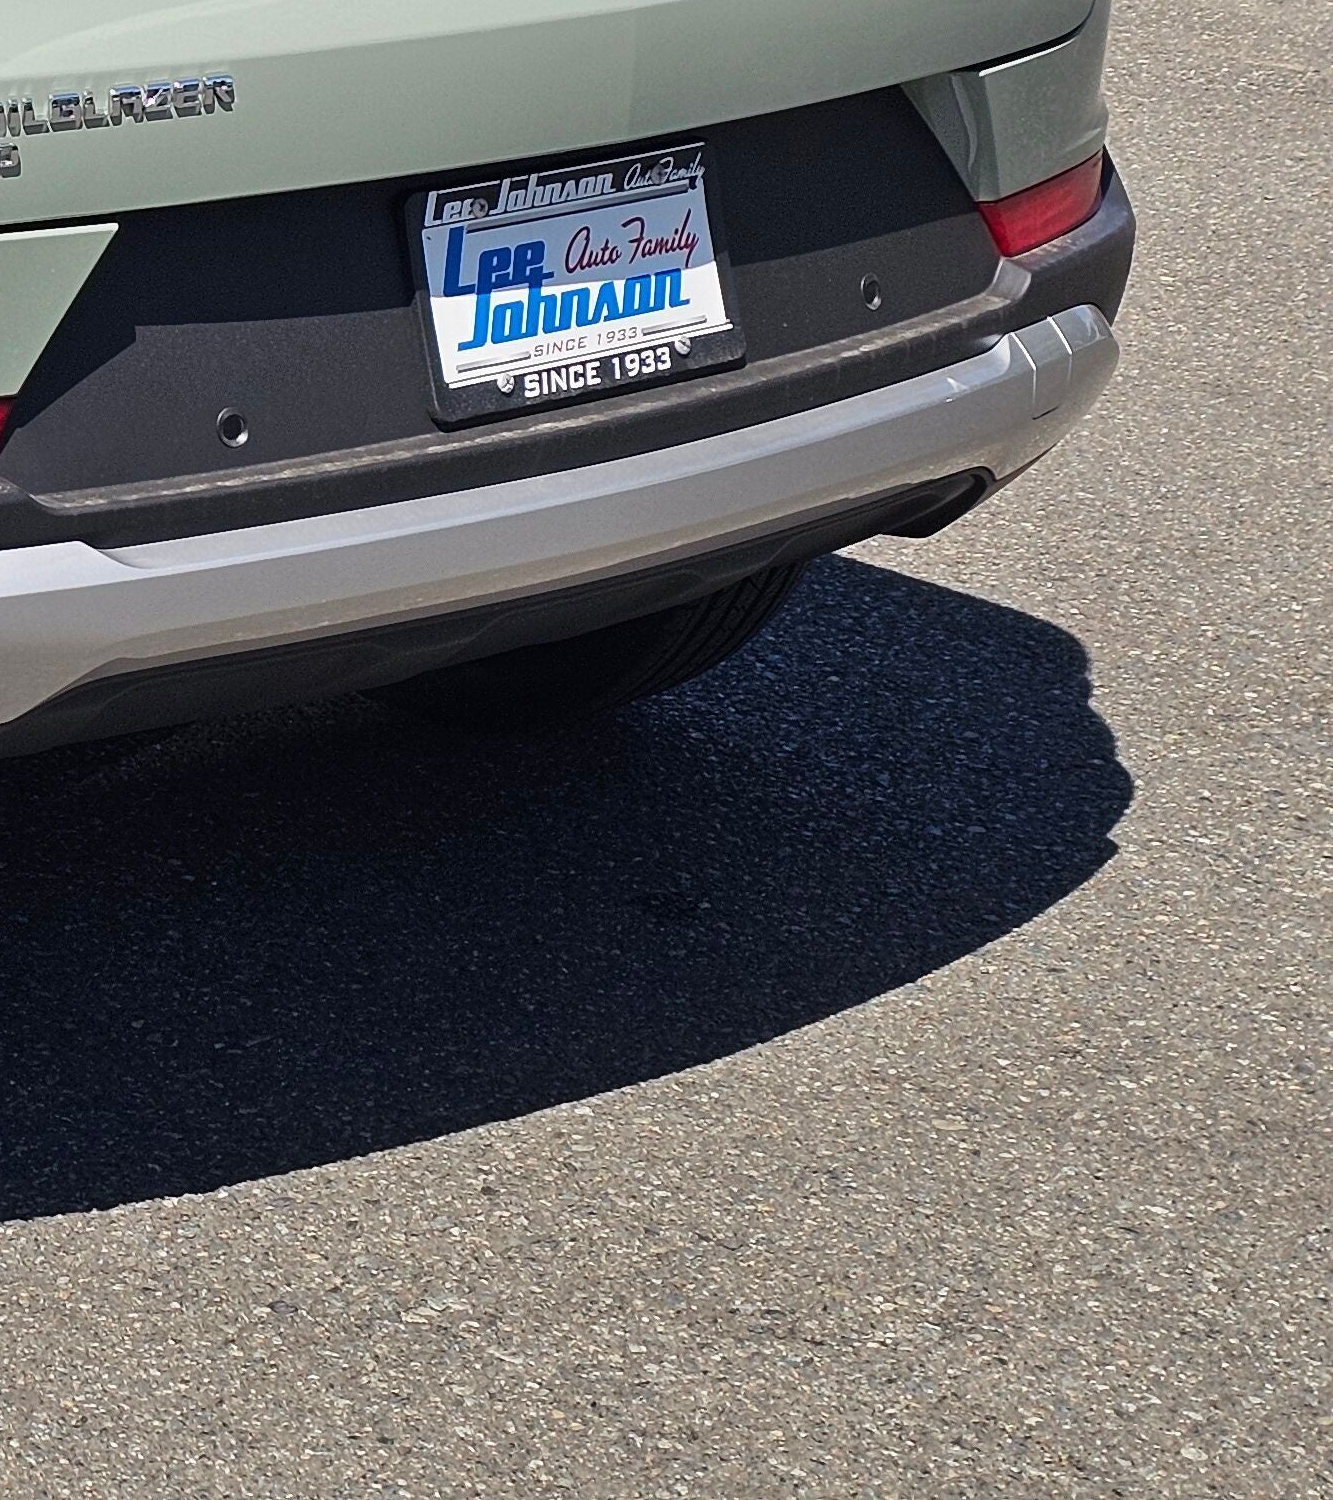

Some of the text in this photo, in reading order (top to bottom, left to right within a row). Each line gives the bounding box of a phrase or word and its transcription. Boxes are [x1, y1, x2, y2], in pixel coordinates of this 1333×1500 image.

[488, 172, 616, 215] Johnson
[624, 162, 659, 190] Aut
[658, 151, 705, 189] Family
[442, 225, 547, 297] Lee
[565, 208, 701, 274] Auto Family
[458, 267, 691, 352] Johnson
[533, 326, 639, 358] SINCE 1933
[524, 347, 673, 398] SINCE 1933
